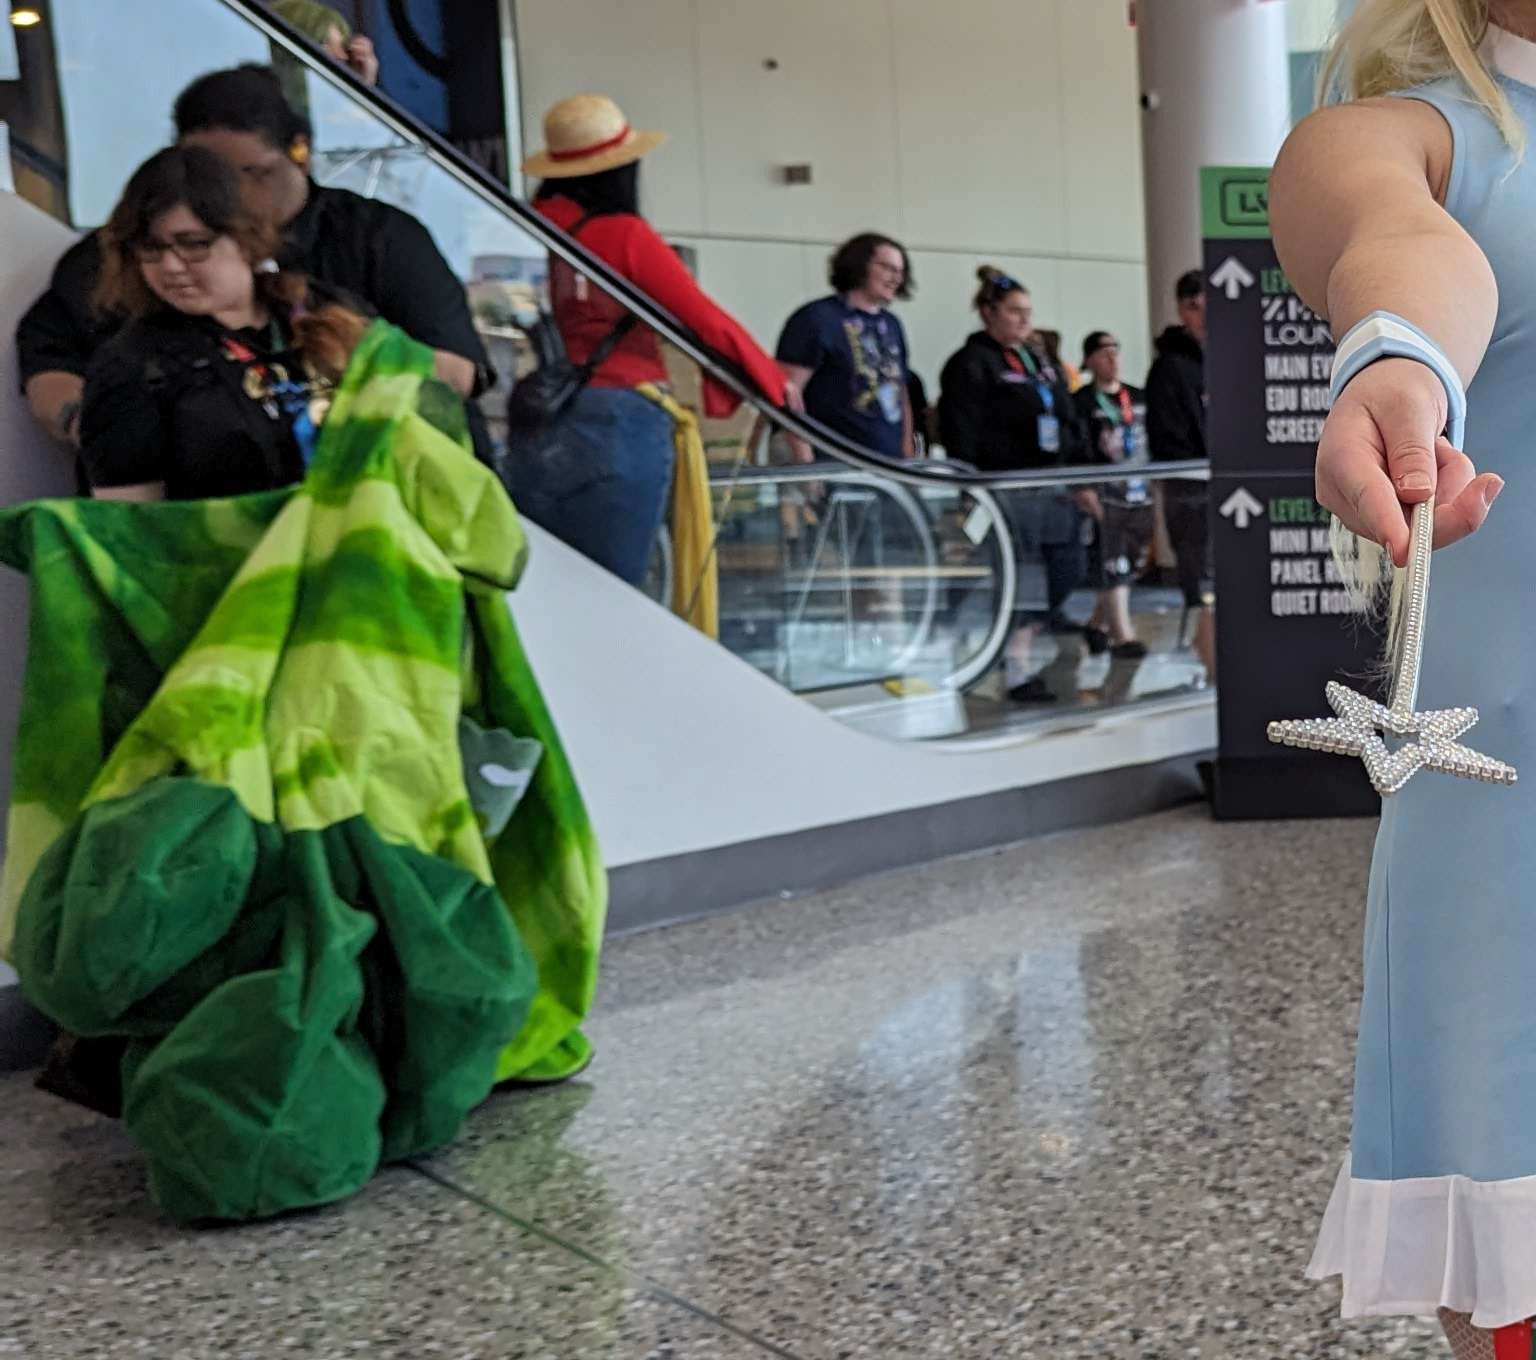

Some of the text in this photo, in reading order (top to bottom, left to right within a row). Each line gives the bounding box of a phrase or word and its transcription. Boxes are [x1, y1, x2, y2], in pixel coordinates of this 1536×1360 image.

[1264, 355, 1308, 380] MAIN
[1265, 386, 1299, 411] EDU
[1269, 499, 1315, 523] LEVEL
[1270, 529, 1308, 553] MINI
[1271, 560, 1321, 585] PANEL
[1271, 591, 1316, 616] QUIET
